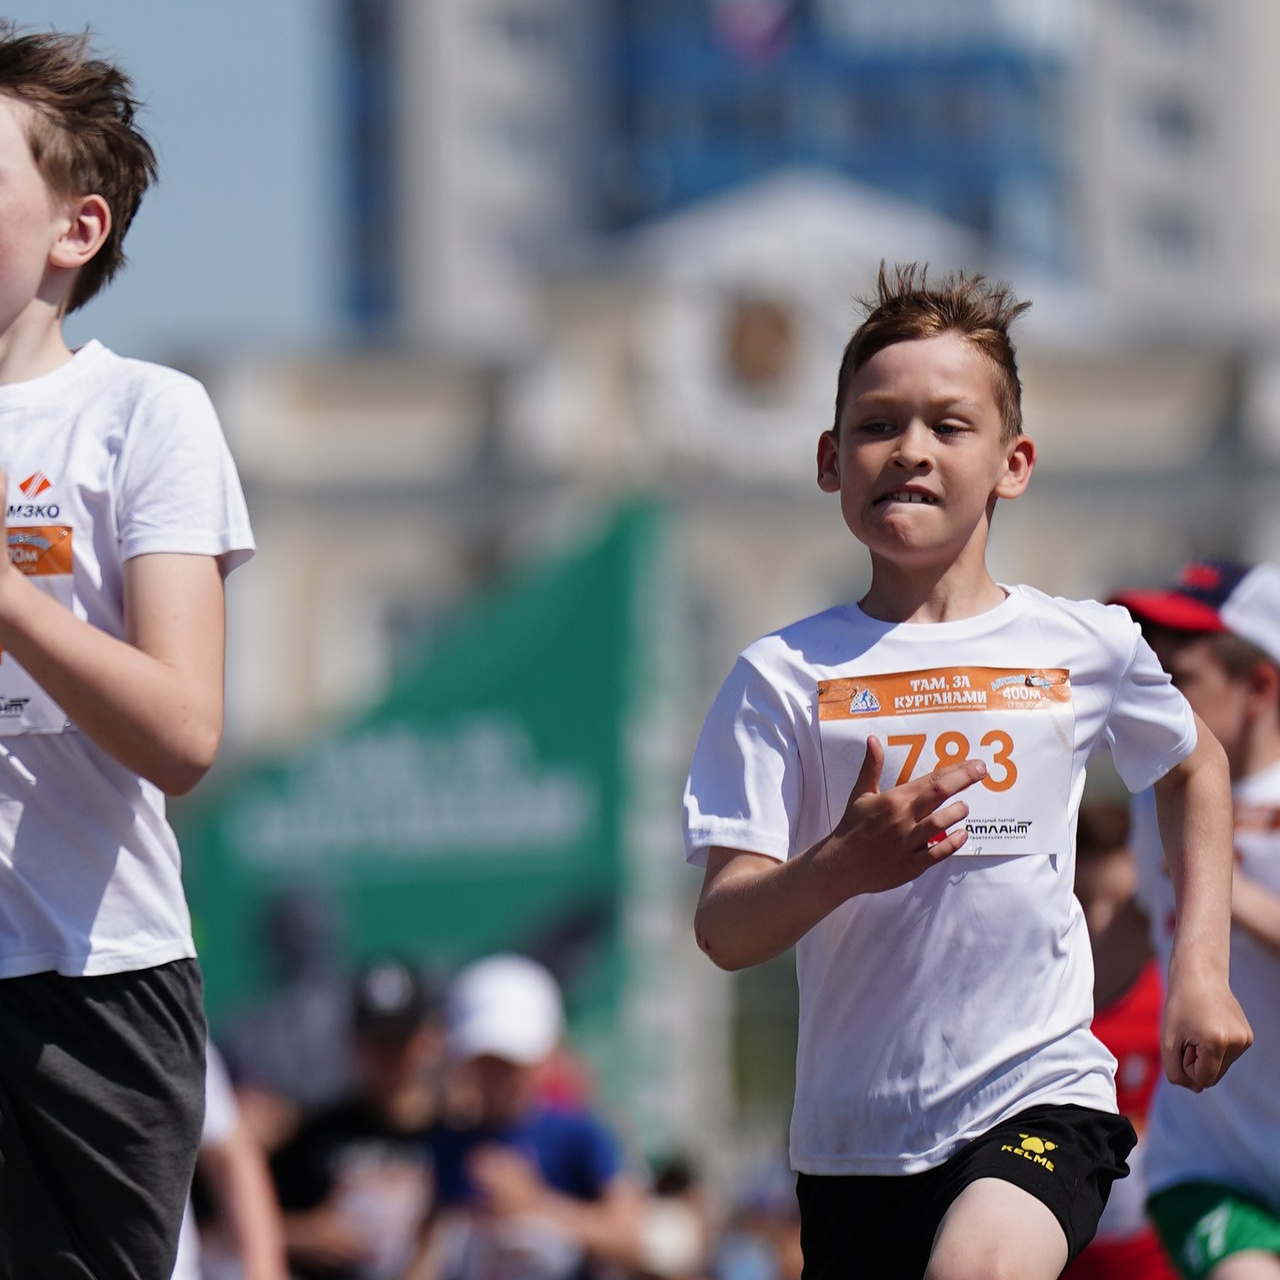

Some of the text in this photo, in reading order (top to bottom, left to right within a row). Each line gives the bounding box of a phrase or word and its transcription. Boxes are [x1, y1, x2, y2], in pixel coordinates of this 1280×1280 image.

[910, 675, 971, 692] ТАМ, ЗА
[894, 691, 987, 708] КУРГАНАМИ
[887, 730, 1017, 792] 783
[1001, 1145, 1054, 1172] KELME
